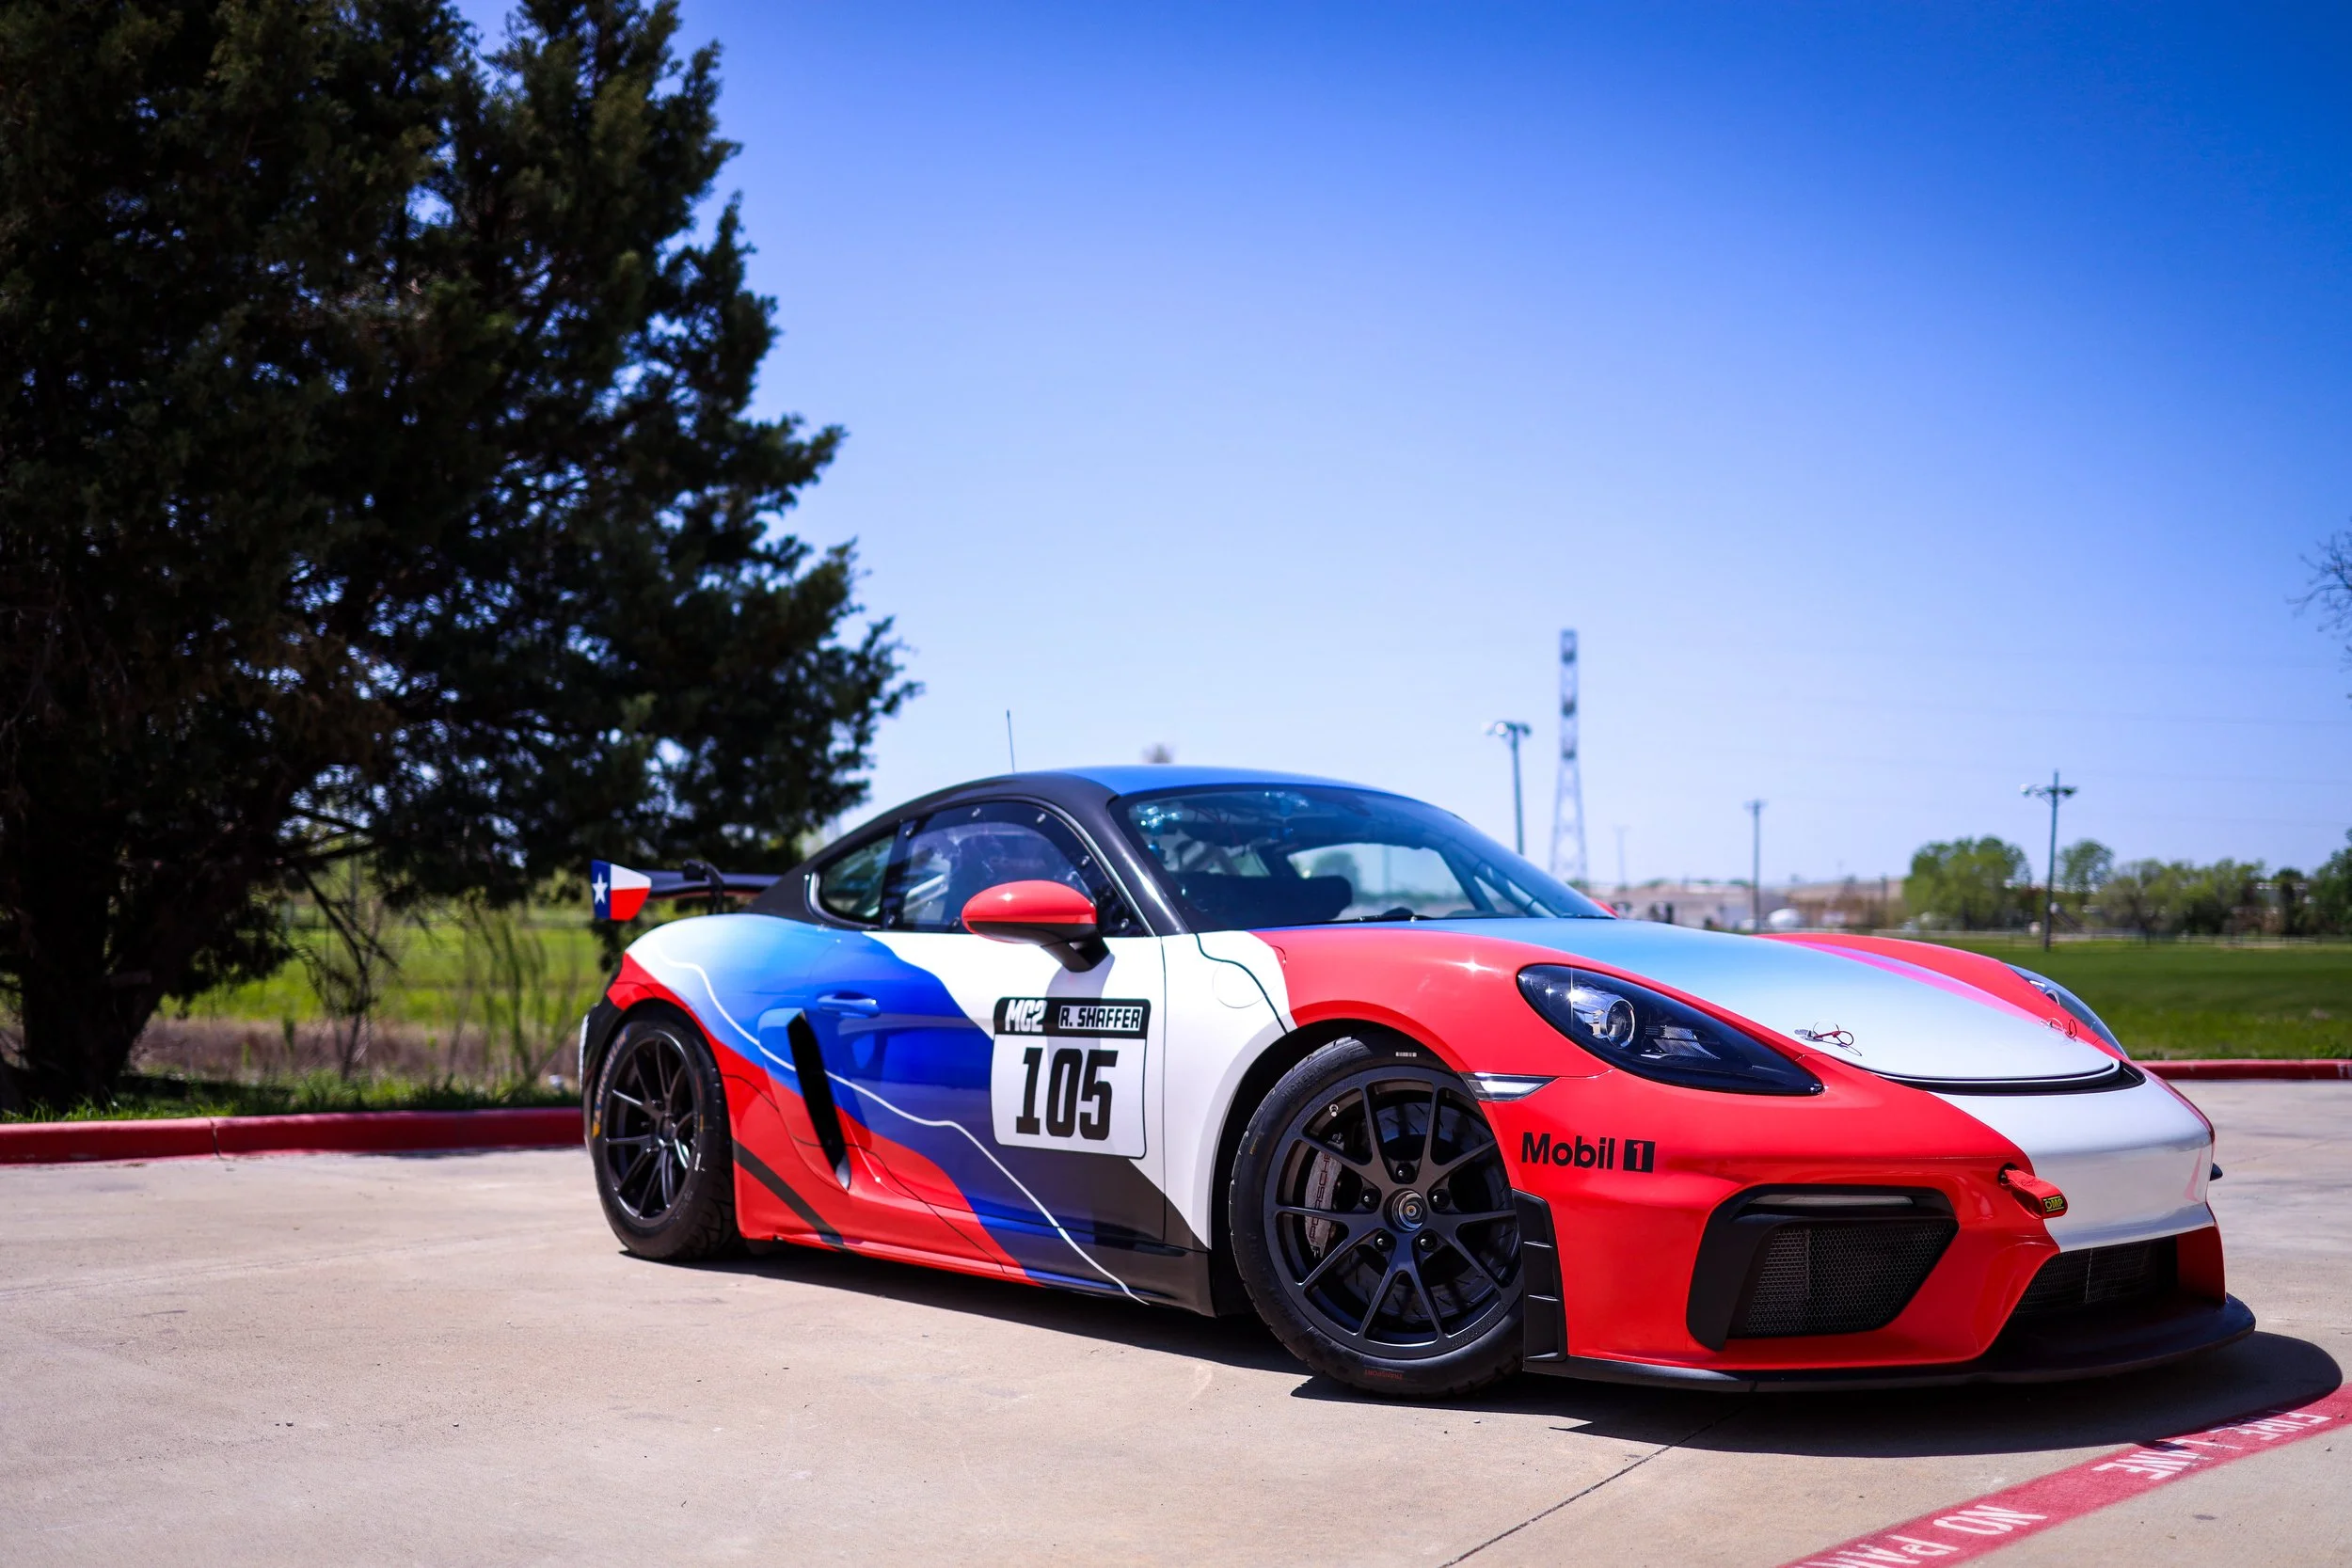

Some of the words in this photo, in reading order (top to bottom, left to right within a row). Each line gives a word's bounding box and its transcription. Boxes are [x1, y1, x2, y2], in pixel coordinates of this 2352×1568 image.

[1005, 999, 1048, 1033] MC2
[1059, 1006, 1074, 1028] R.
[1077, 1006, 1140, 1029] SHAFFER
[1016, 1047, 1119, 1140] 105
[1521, 1132, 1616, 1169] Mobil
[2044, 1198, 2063, 1210] OMP
[2209, 1411, 2332, 1441] FIRE
[2091, 1439, 2243, 1481] LANE
[1932, 1504, 2048, 1535] NO
